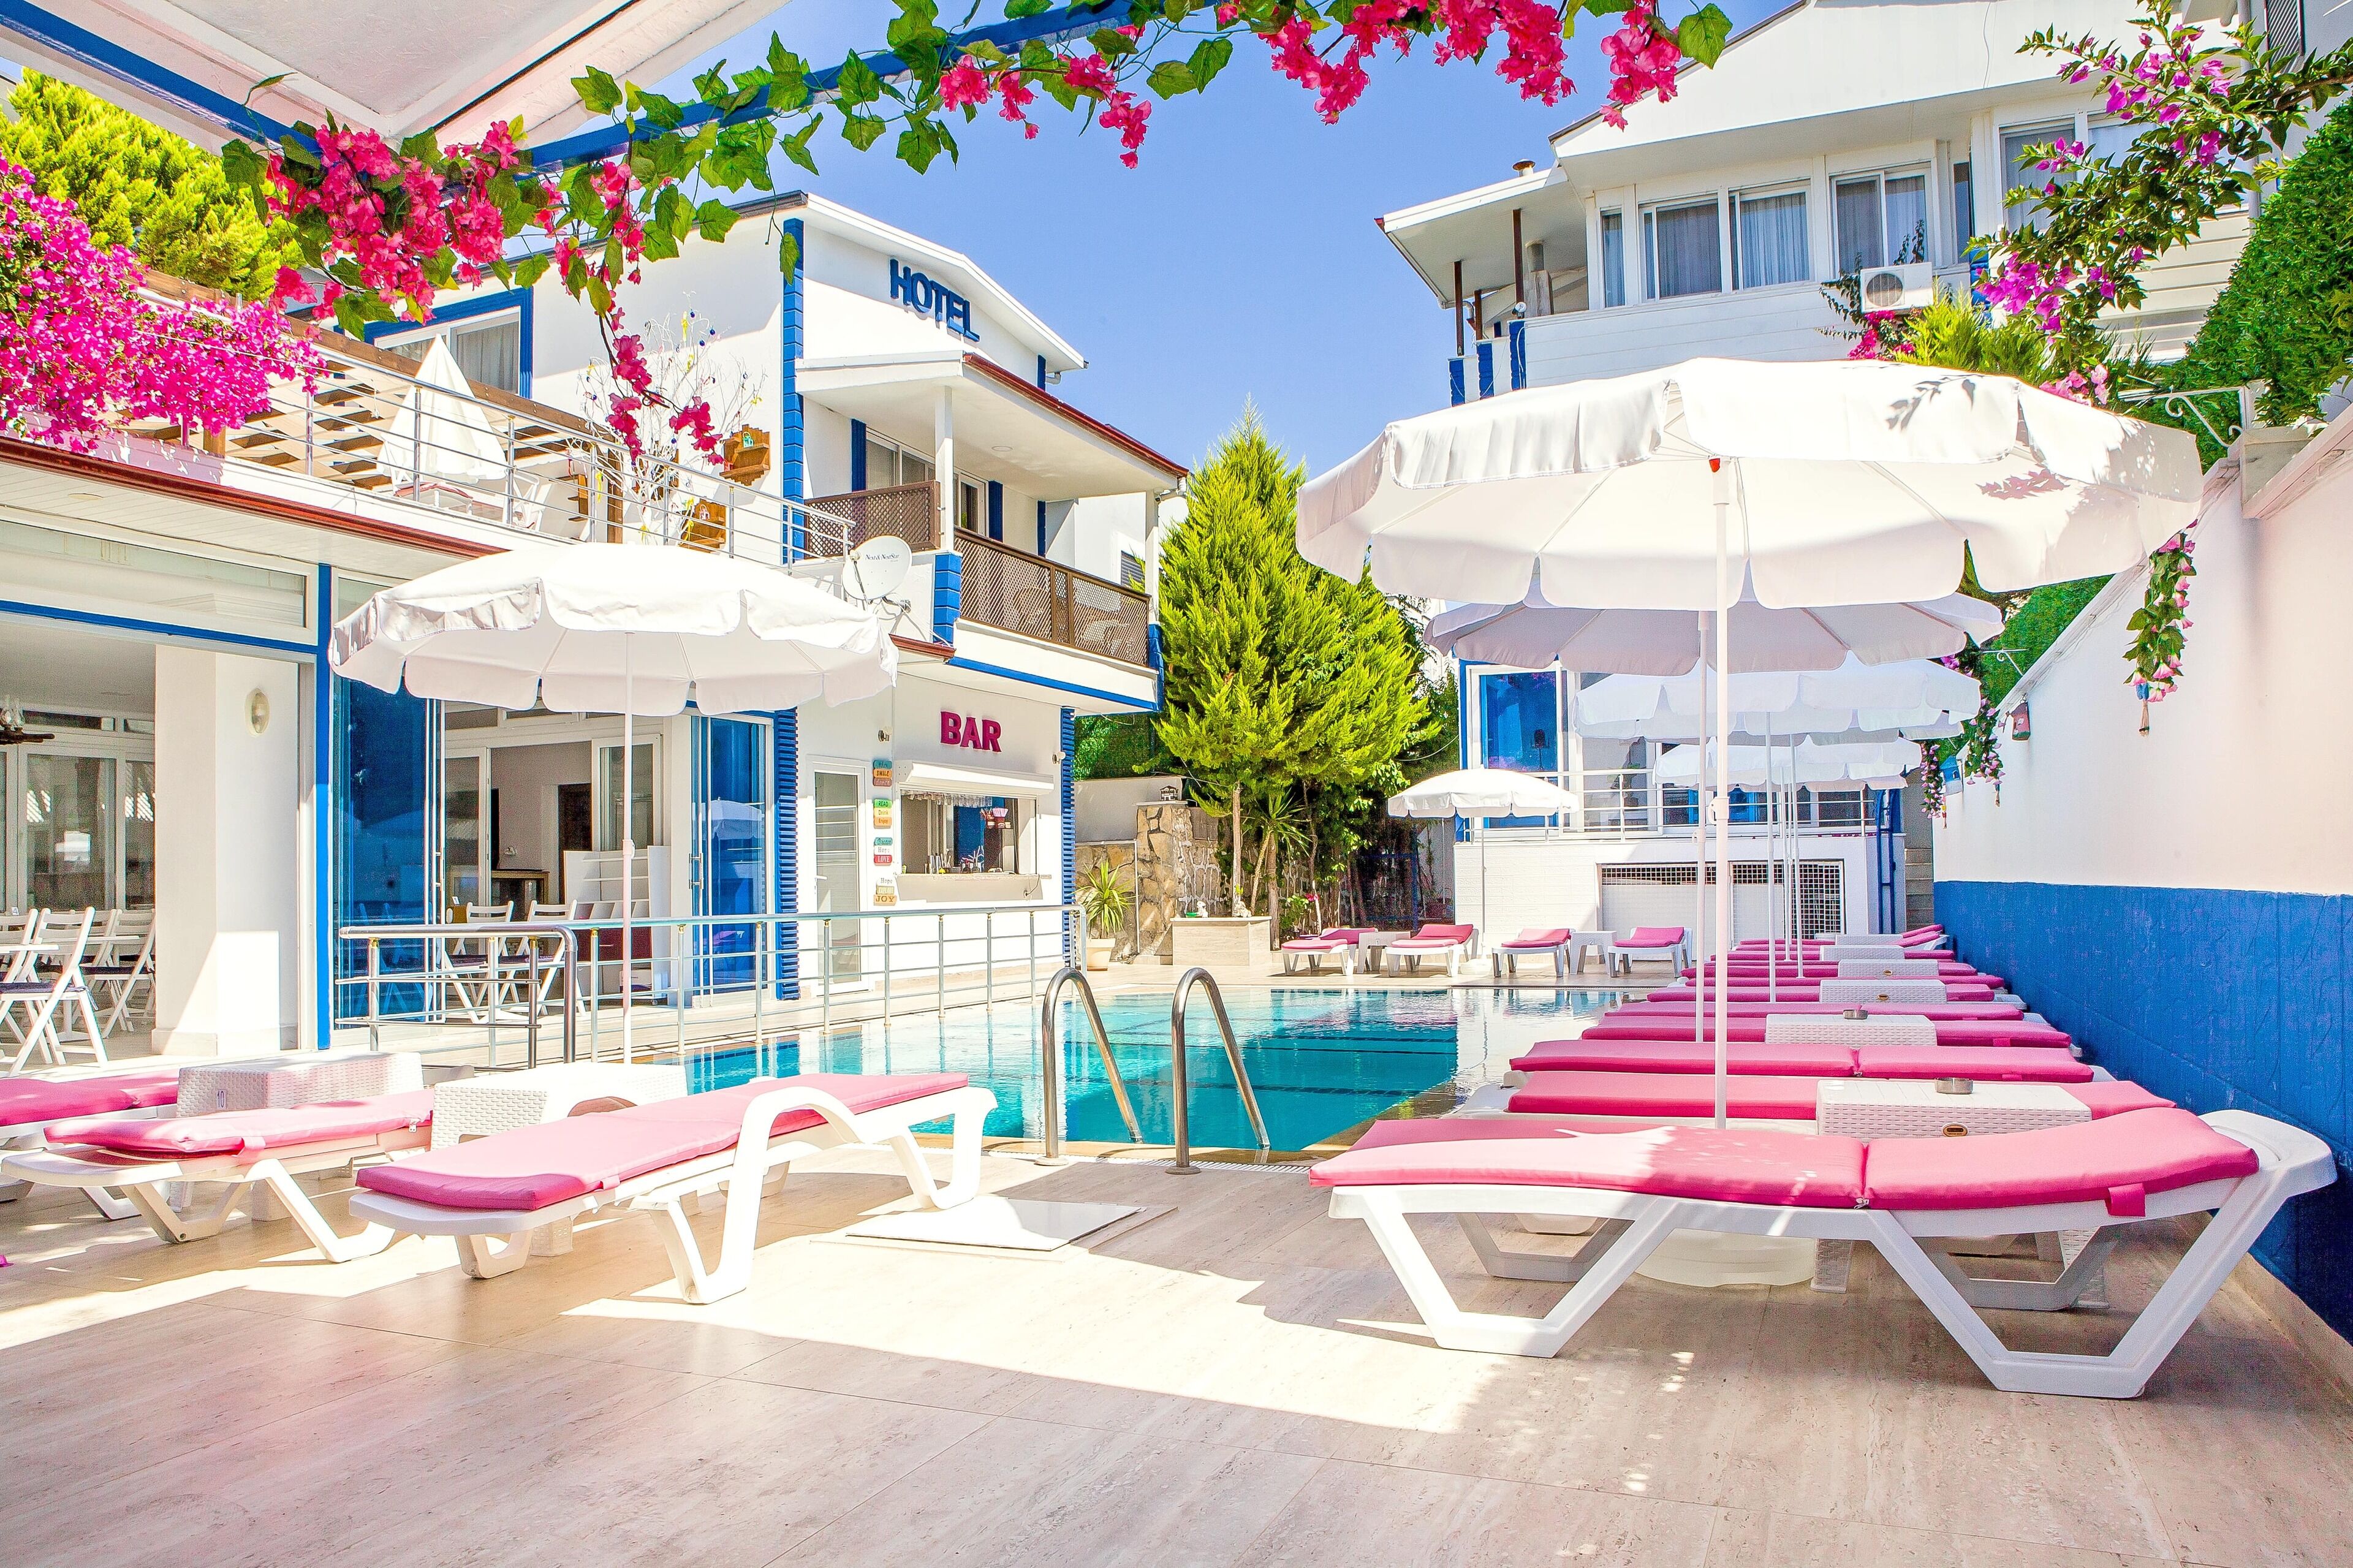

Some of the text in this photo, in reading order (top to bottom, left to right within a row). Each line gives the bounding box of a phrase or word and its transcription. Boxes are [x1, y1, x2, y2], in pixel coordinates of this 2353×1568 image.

[890, 258, 980, 342] HOTEL
[941, 711, 1002, 752] BAR
[217, 1090, 225, 1108] 10
